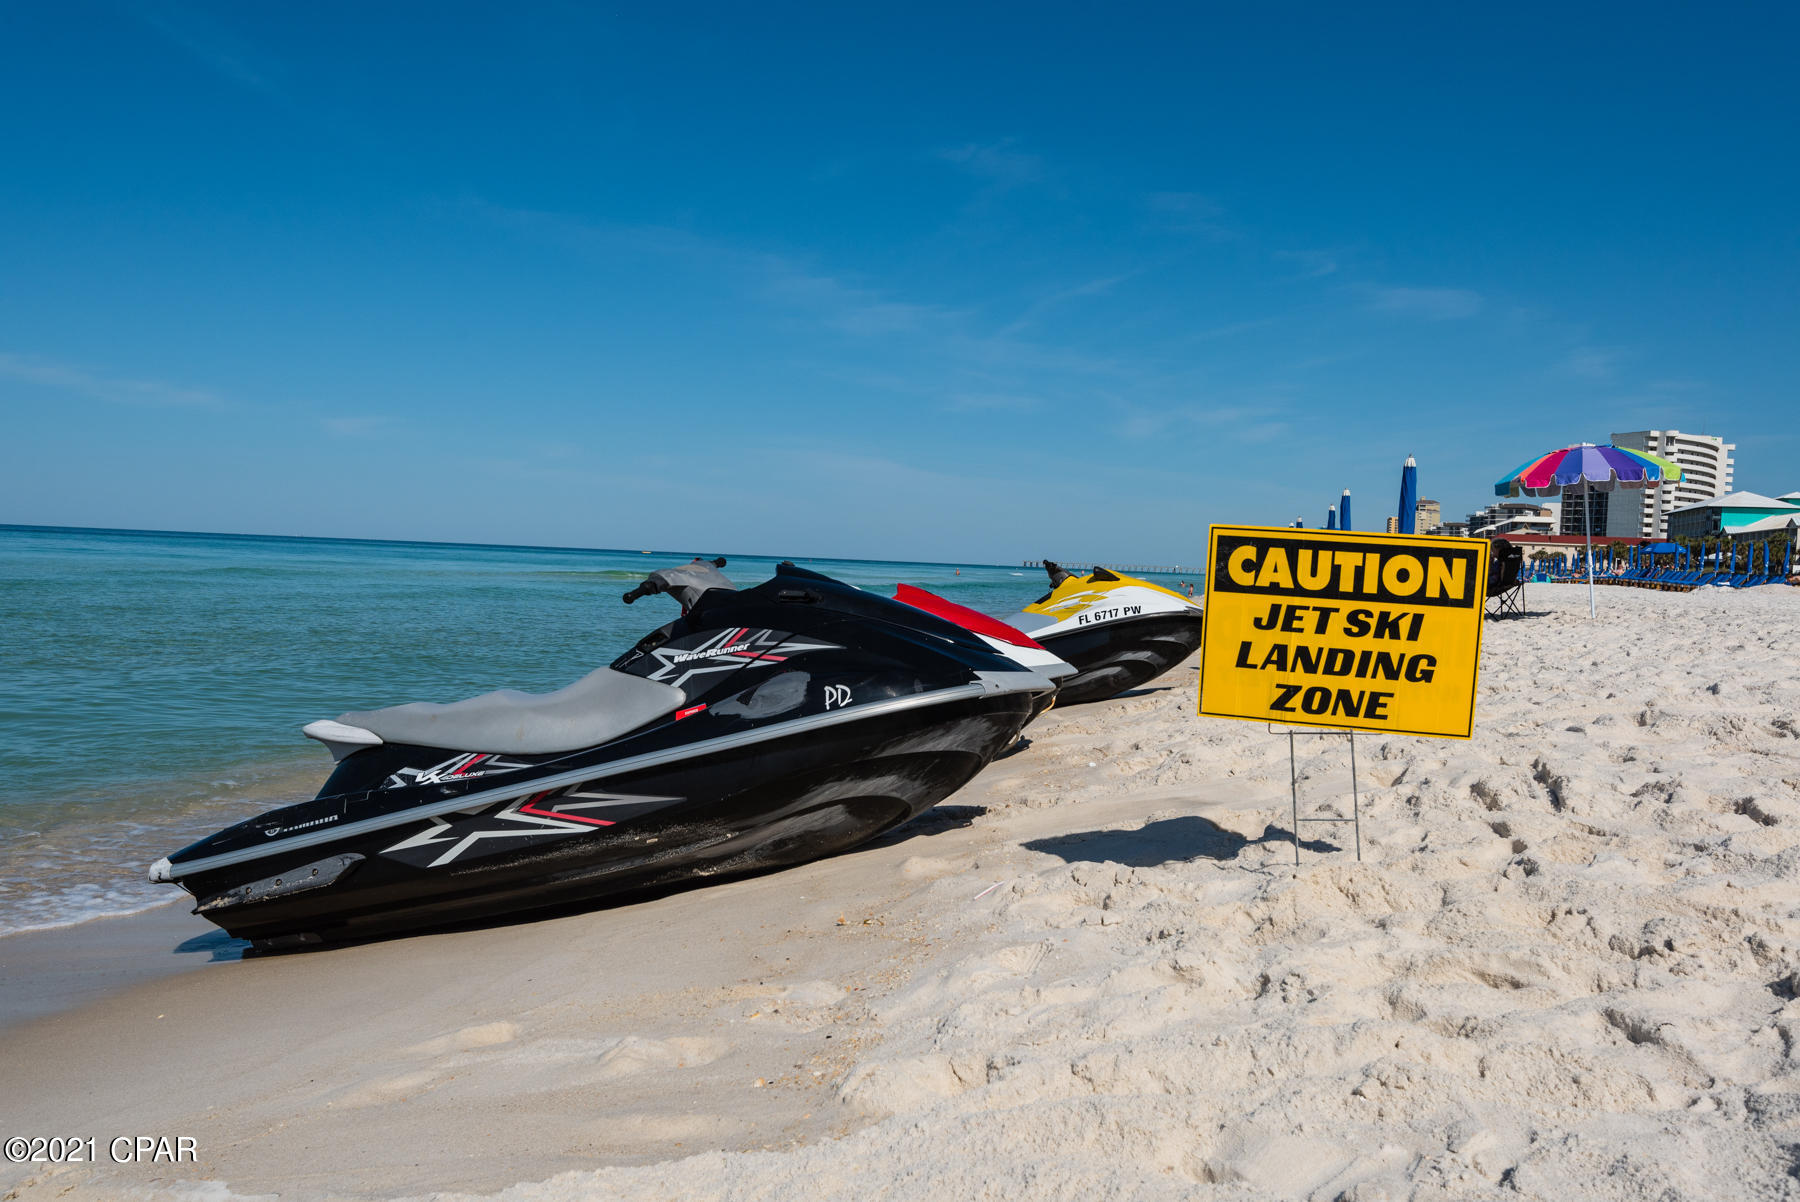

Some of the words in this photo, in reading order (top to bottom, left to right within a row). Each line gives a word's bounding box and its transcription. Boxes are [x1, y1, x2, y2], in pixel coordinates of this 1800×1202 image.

[1228, 545, 1467, 600] CAUTION
[1078, 614, 1091, 625] FL
[1094, 608, 1119, 621] 6717
[1123, 605, 1141, 616] PW
[1253, 603, 1340, 635] JET
[1343, 608, 1425, 641] SKI
[673, 643, 751, 663] WaveRunner
[1235, 641, 1437, 683] LANDING
[1270, 683, 1395, 720] ZONE
